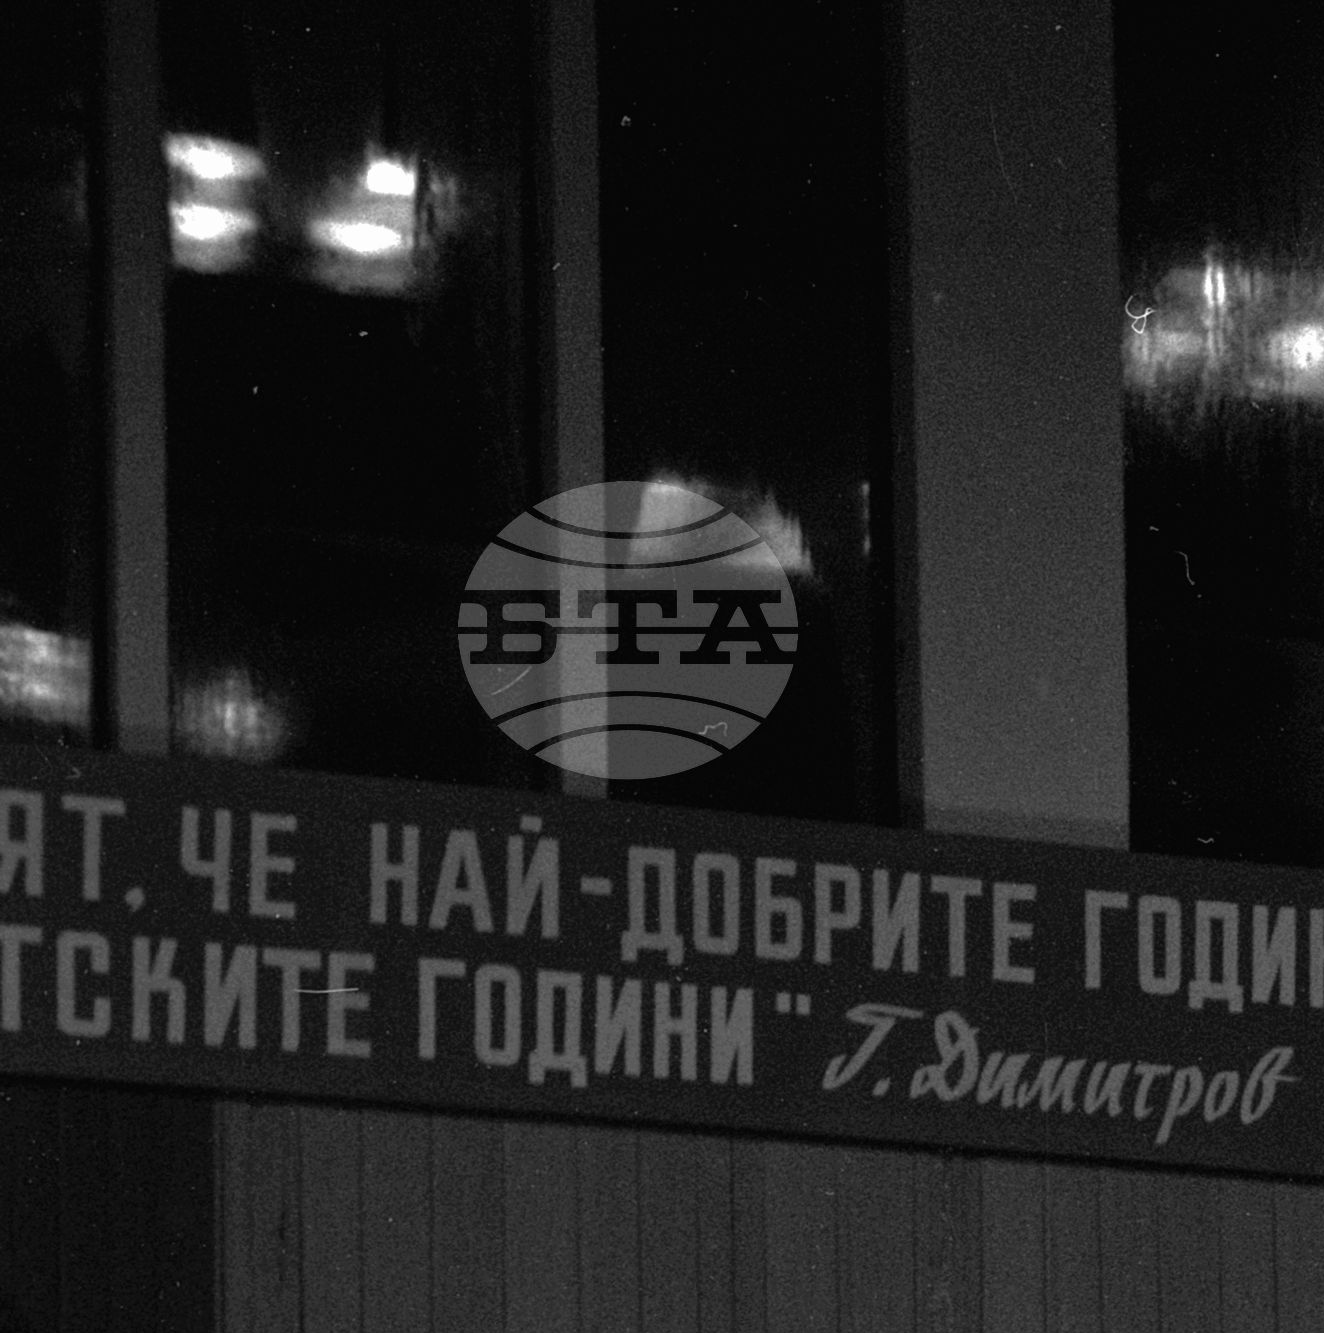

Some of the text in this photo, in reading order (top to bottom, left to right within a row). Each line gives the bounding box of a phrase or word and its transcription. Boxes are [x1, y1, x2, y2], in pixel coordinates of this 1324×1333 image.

[179, 805, 298, 920] ЧЕ
[369, 815, 1037, 984] НАЙ-ДОБРИТЕ
[0, 923, 376, 1059] ТСКИТЕ
